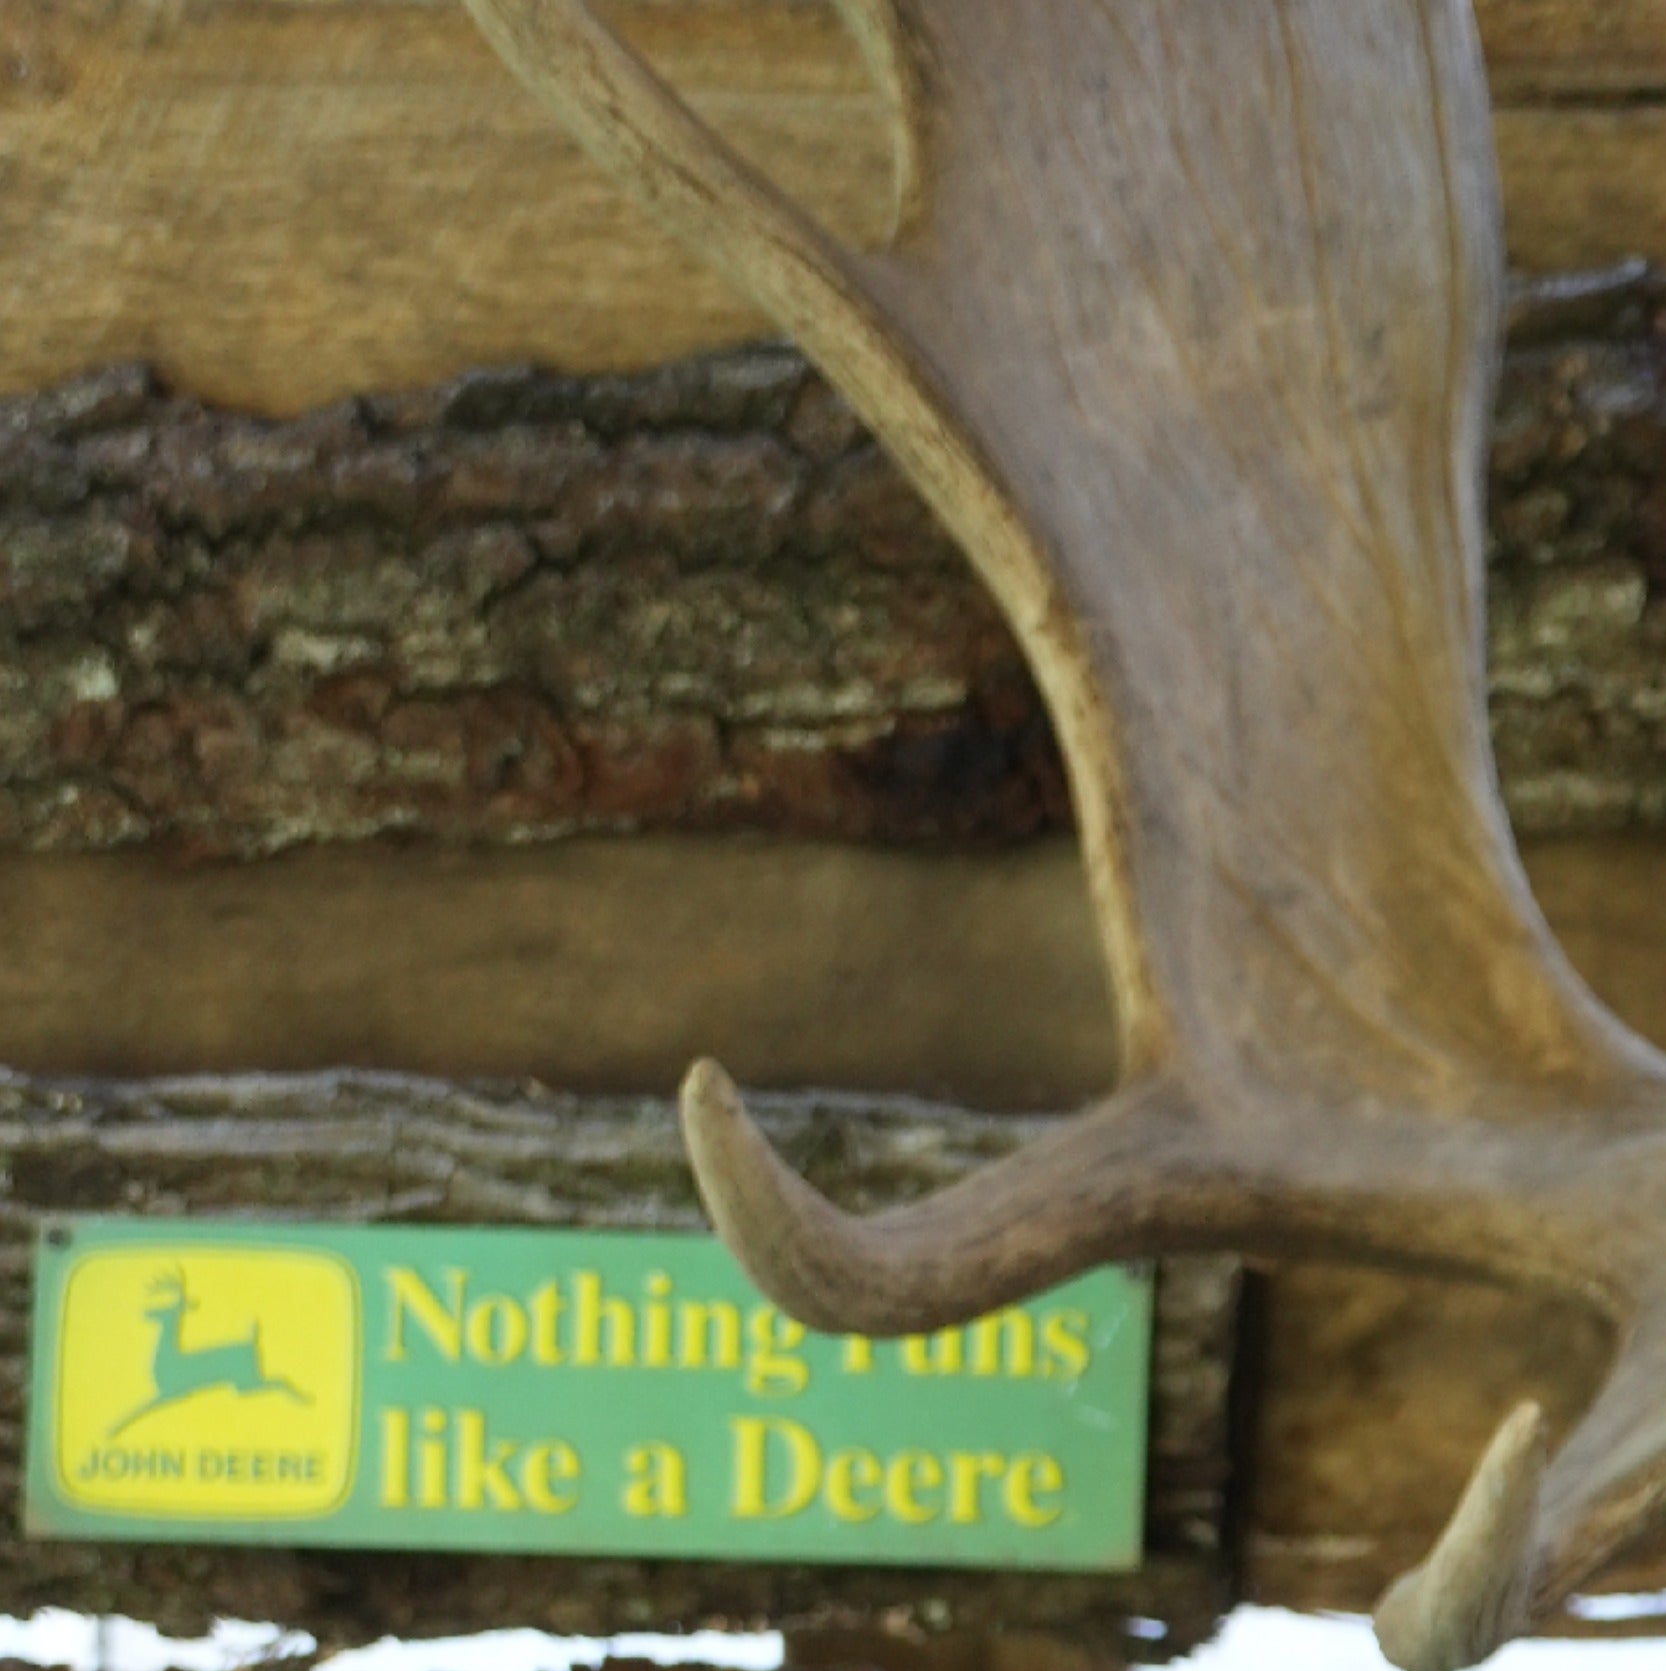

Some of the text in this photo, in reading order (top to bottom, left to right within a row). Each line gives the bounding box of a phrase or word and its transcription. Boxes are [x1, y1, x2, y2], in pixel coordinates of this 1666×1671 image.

[382, 1264, 810, 1396] Nothing
[79, 1447, 327, 1484] JOHN DEERE
[377, 1408, 1065, 1524] like a Deere
